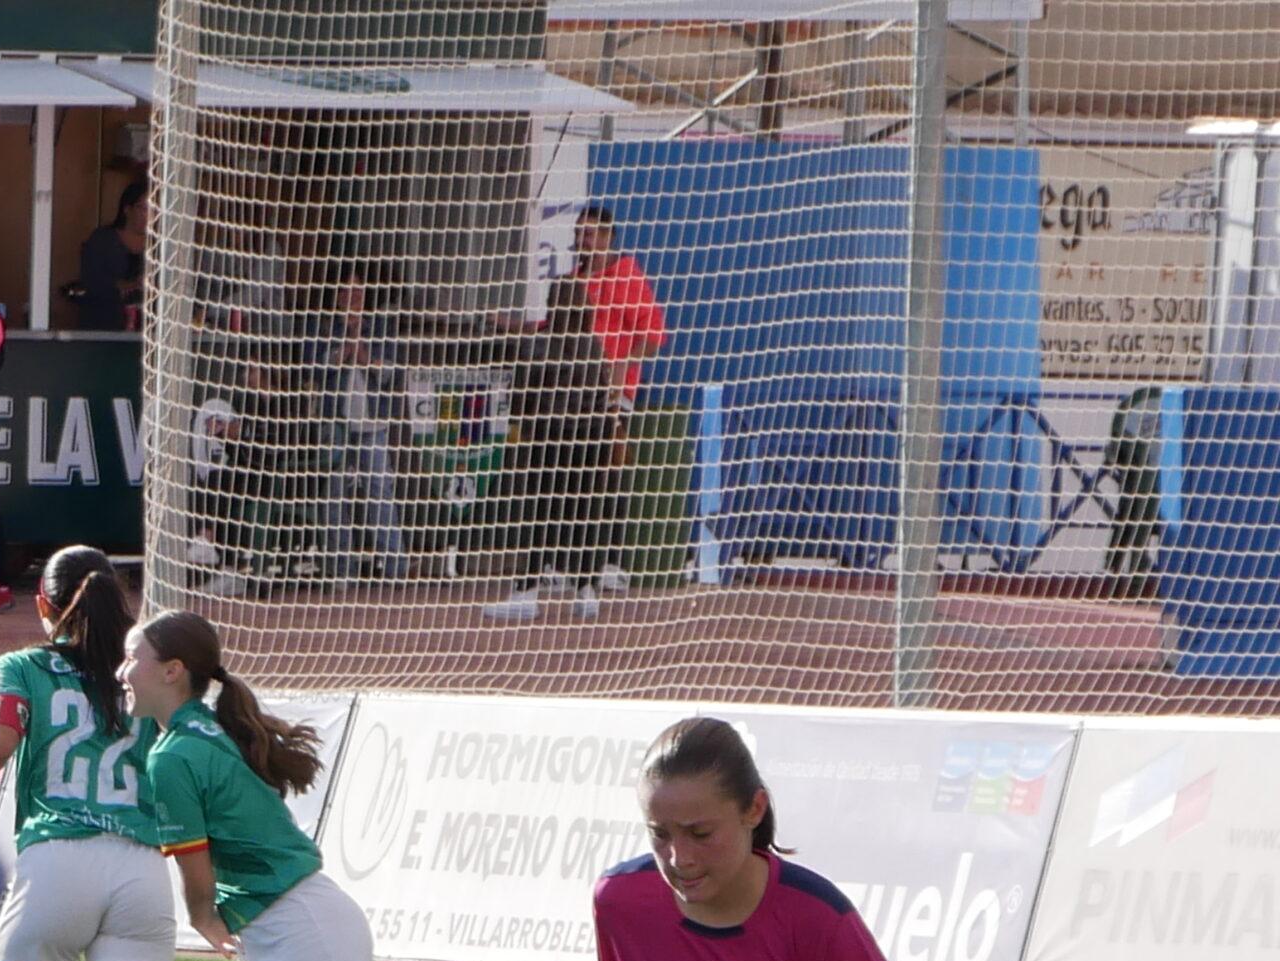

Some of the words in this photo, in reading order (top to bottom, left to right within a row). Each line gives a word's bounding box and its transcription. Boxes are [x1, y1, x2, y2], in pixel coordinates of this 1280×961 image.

[28, 397, 100, 486] LA
[45, 687, 140, 807] 22
[426, 730, 650, 789] HORMIGONE
[431, 811, 558, 880] MORENO
[376, 908, 404, 940] 55
